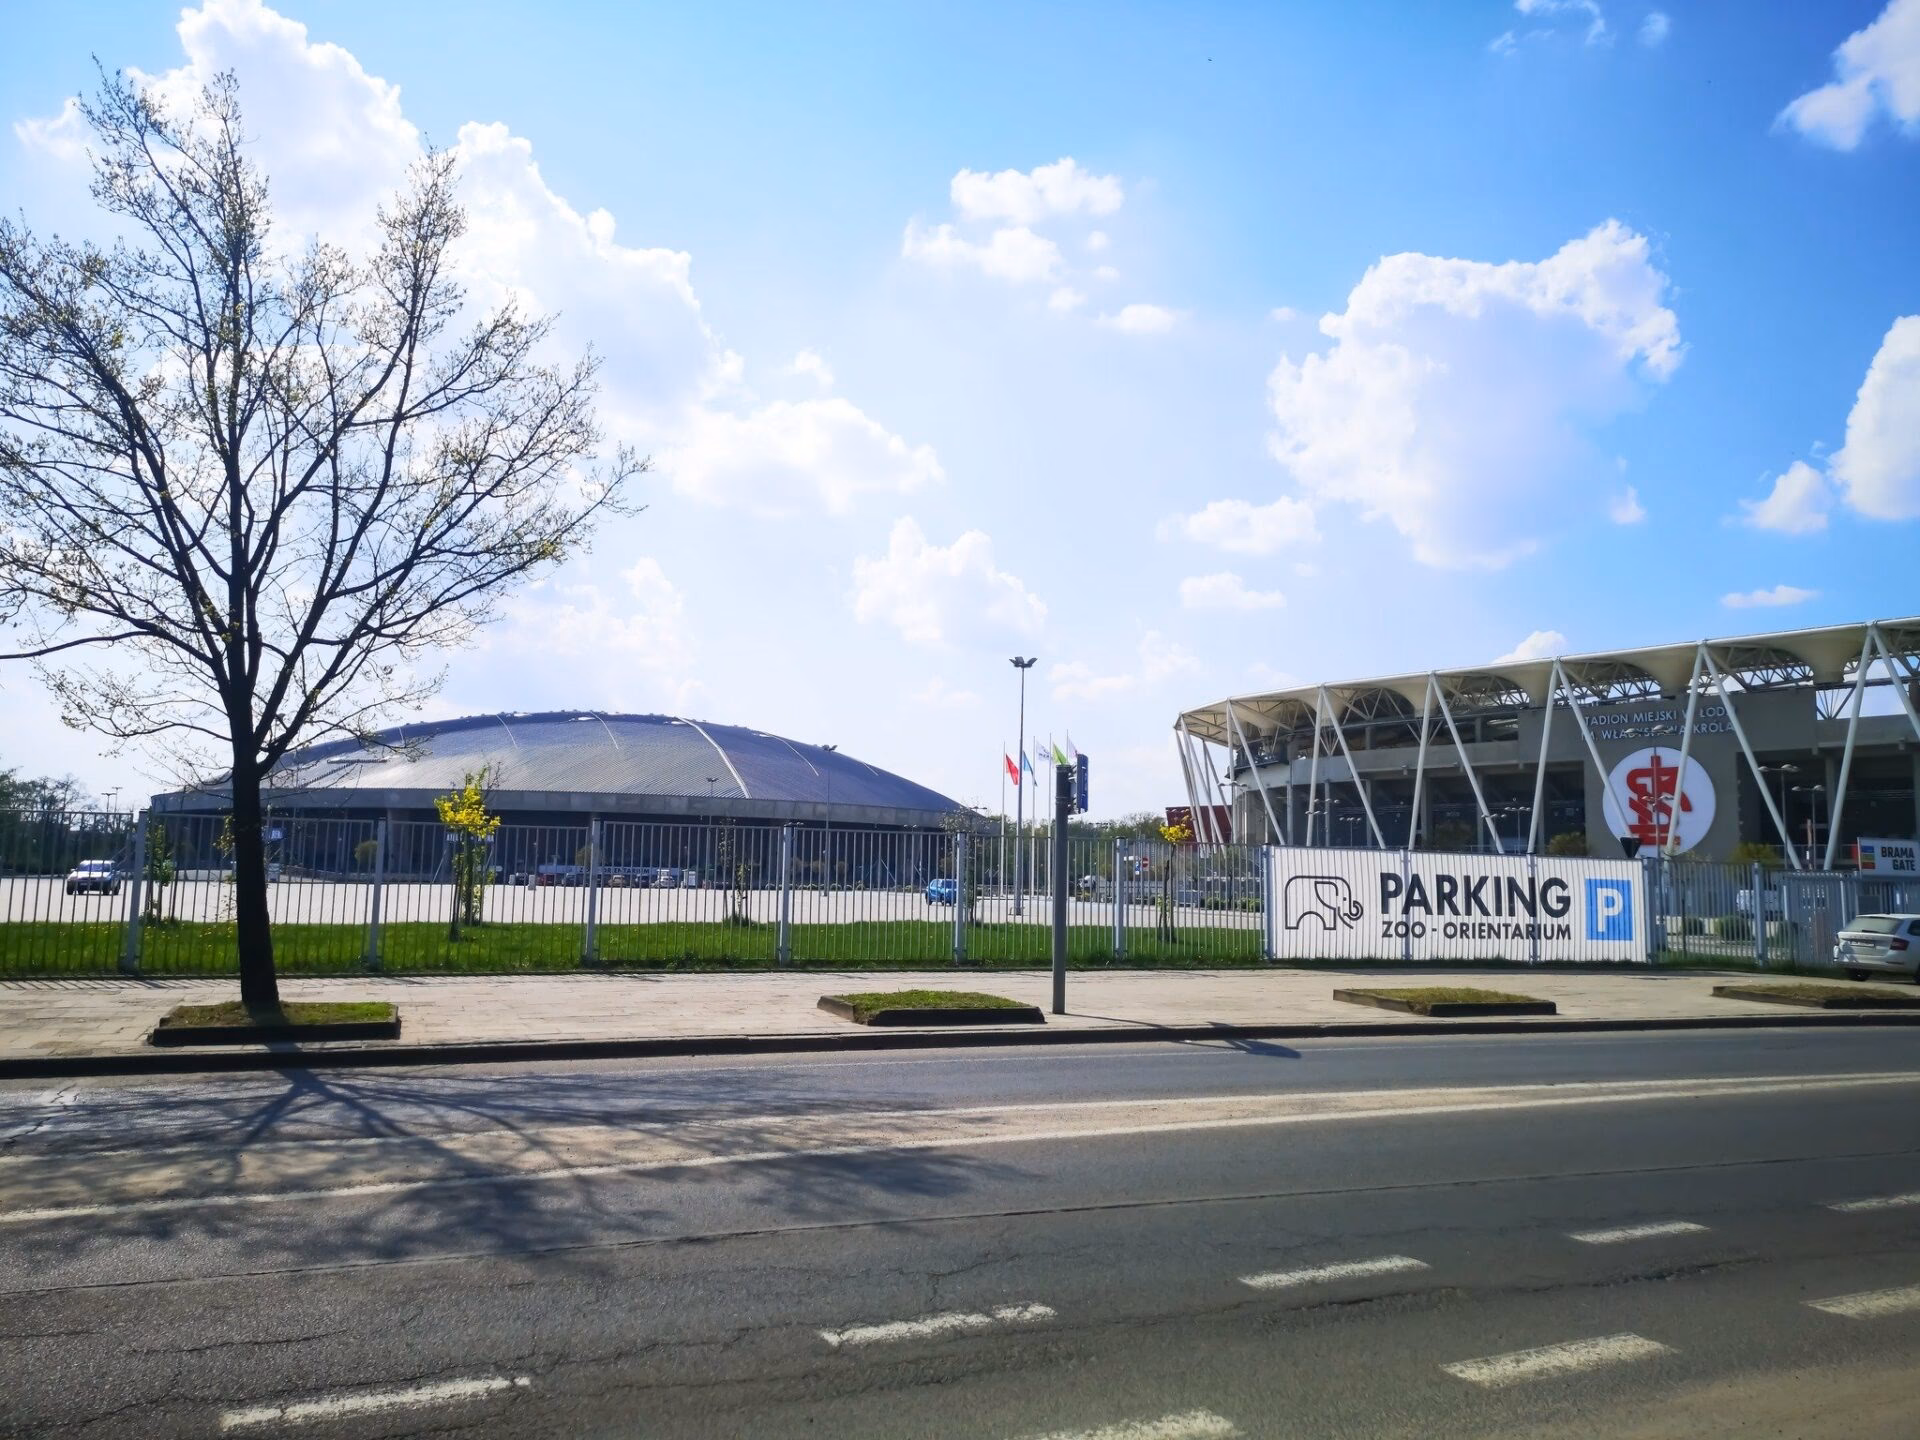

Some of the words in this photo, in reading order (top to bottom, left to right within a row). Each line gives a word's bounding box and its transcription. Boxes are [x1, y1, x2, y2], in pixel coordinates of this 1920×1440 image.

[1583, 714, 1628, 726] TADION
[1633, 709, 1676, 722] MIEJSKI
[1698, 706, 1731, 717] ŁOD
[1693, 720, 1735, 734] KRÓLA
[1881, 846, 1915, 858] BRAMA
[1892, 859, 1916, 871] GATE
[1380, 872, 1571, 918] PARKING
[1596, 887, 1623, 932] P
[1382, 921, 1426, 938] ZOO
[1443, 921, 1571, 940] ORIENTARIUM
